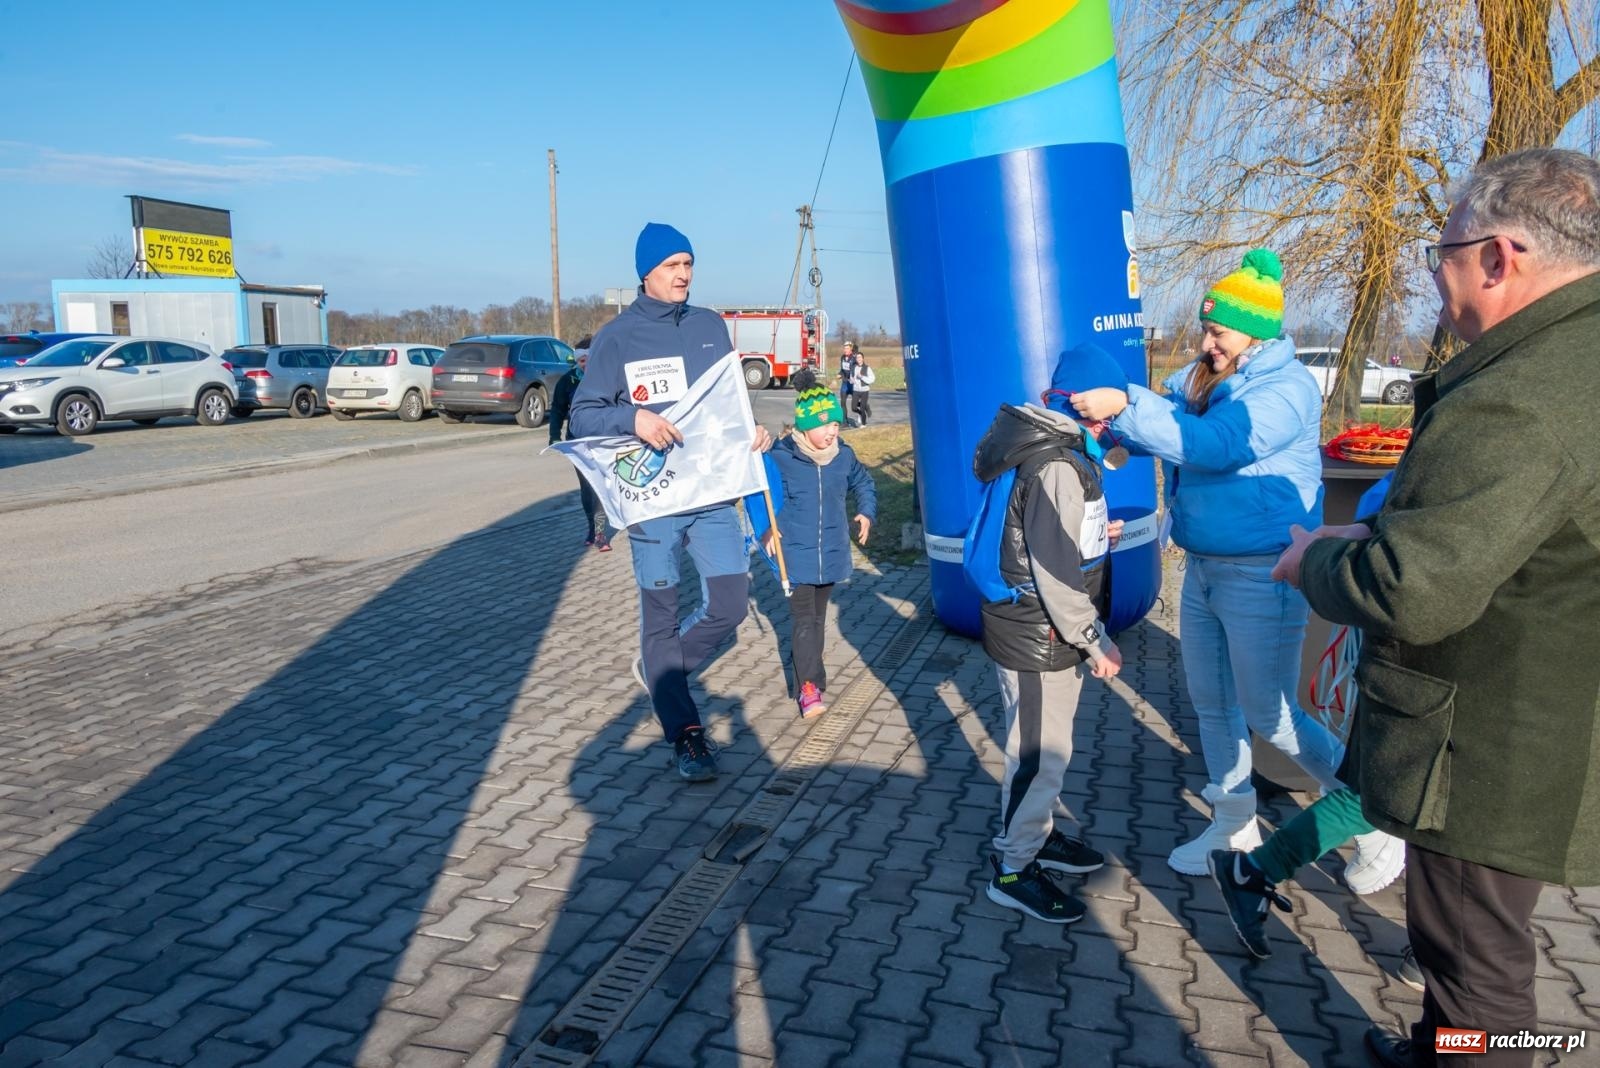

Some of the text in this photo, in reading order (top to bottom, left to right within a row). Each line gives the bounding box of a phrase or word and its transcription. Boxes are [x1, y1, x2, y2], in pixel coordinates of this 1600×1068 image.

[159, 234, 219, 247] WYWÓZ SZAMBA
[147, 243, 232, 265] 575 792 626
[1093, 312, 1133, 332] GMINA
[650, 379, 669, 395] 13
